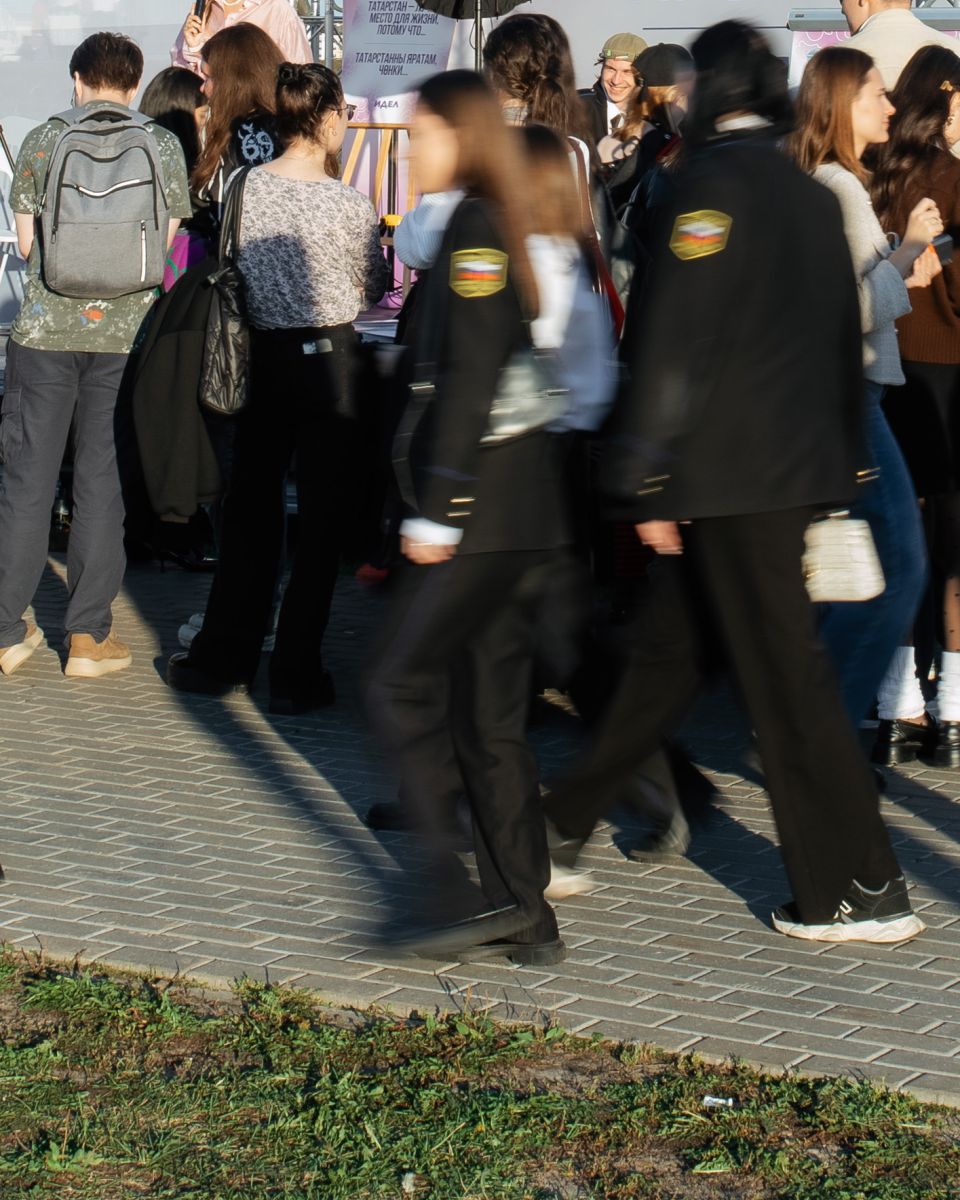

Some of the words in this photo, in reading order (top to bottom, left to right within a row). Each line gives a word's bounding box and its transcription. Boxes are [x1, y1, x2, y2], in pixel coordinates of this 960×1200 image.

[368, 0, 408, 12] ТАТАРСТАН
[369, 12, 394, 24] МЕСТО
[393, 13, 410, 24] ДЛЯ
[411, 13, 439, 25] ЖИЗНИ,
[377, 24, 407, 35] ПОТОМУ
[355, 52, 406, 64] ТАТАРСТАННЫ
[374, 100, 399, 109] ИДЕЛ
